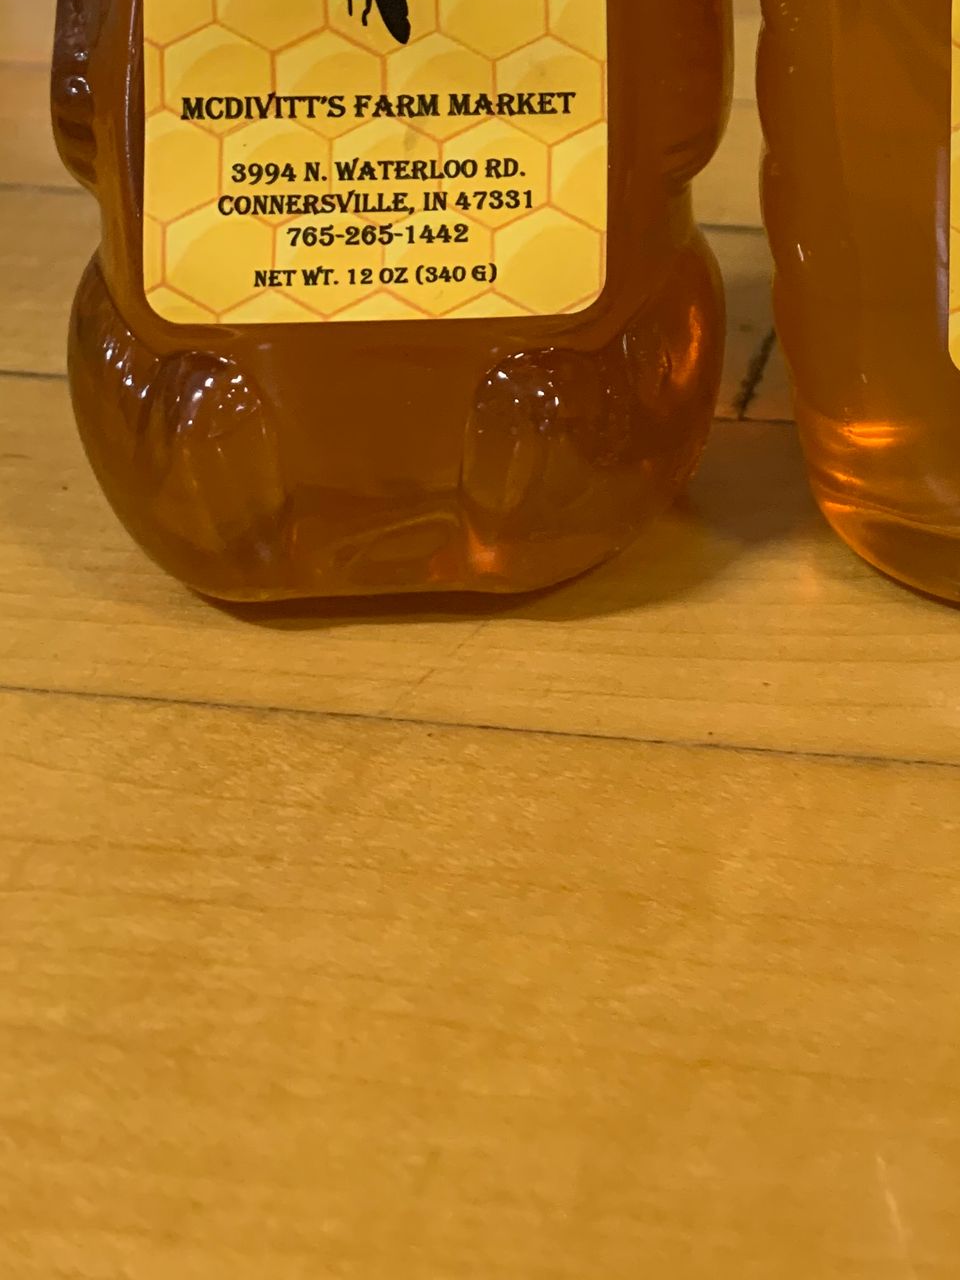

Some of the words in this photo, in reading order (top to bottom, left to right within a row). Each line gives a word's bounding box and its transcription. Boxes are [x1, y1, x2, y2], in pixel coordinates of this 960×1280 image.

[180, 91, 346, 121] MCDIVITT'S
[353, 94, 440, 119] FARM
[447, 91, 577, 117] MARKET
[231, 162, 297, 186] 3994
[303, 161, 328, 182] N.
[334, 157, 478, 181] WATERLOO
[484, 158, 526, 179] RD.
[217, 189, 415, 216] CONNERSVILLE,
[423, 191, 448, 212] IN
[455, 189, 532, 211] 47331
[286, 223, 469, 247] 765-265-1442
[254, 269, 297, 287] NET
[301, 266, 339, 286] WT.
[348, 268, 373, 285] 12
[379, 267, 409, 284] OZ
[415, 265, 466, 285] (340
[471, 263, 497, 283] G)
